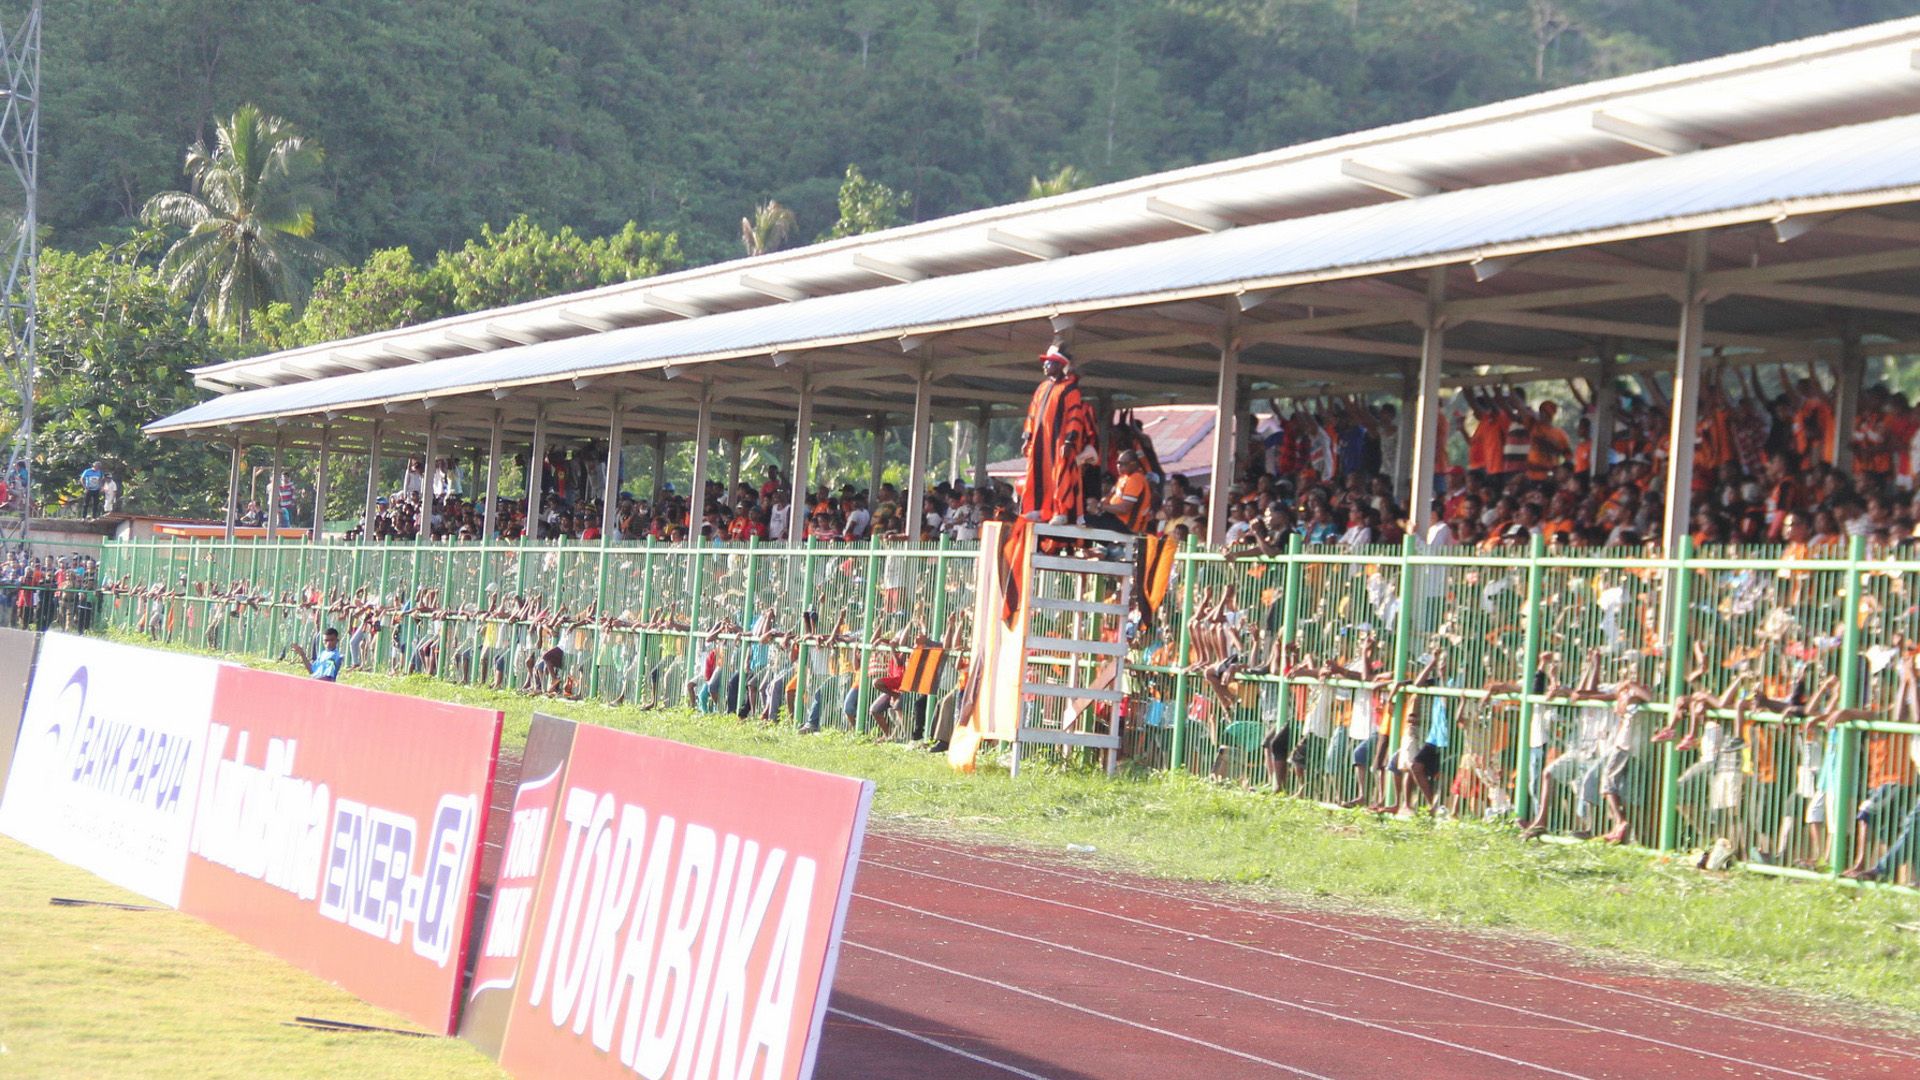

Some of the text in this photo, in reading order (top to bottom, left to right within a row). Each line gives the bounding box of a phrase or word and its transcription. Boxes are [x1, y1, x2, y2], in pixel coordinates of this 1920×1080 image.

[72, 715, 192, 813] BANK PAPUA
[528, 787, 817, 1080] TORABIKA
